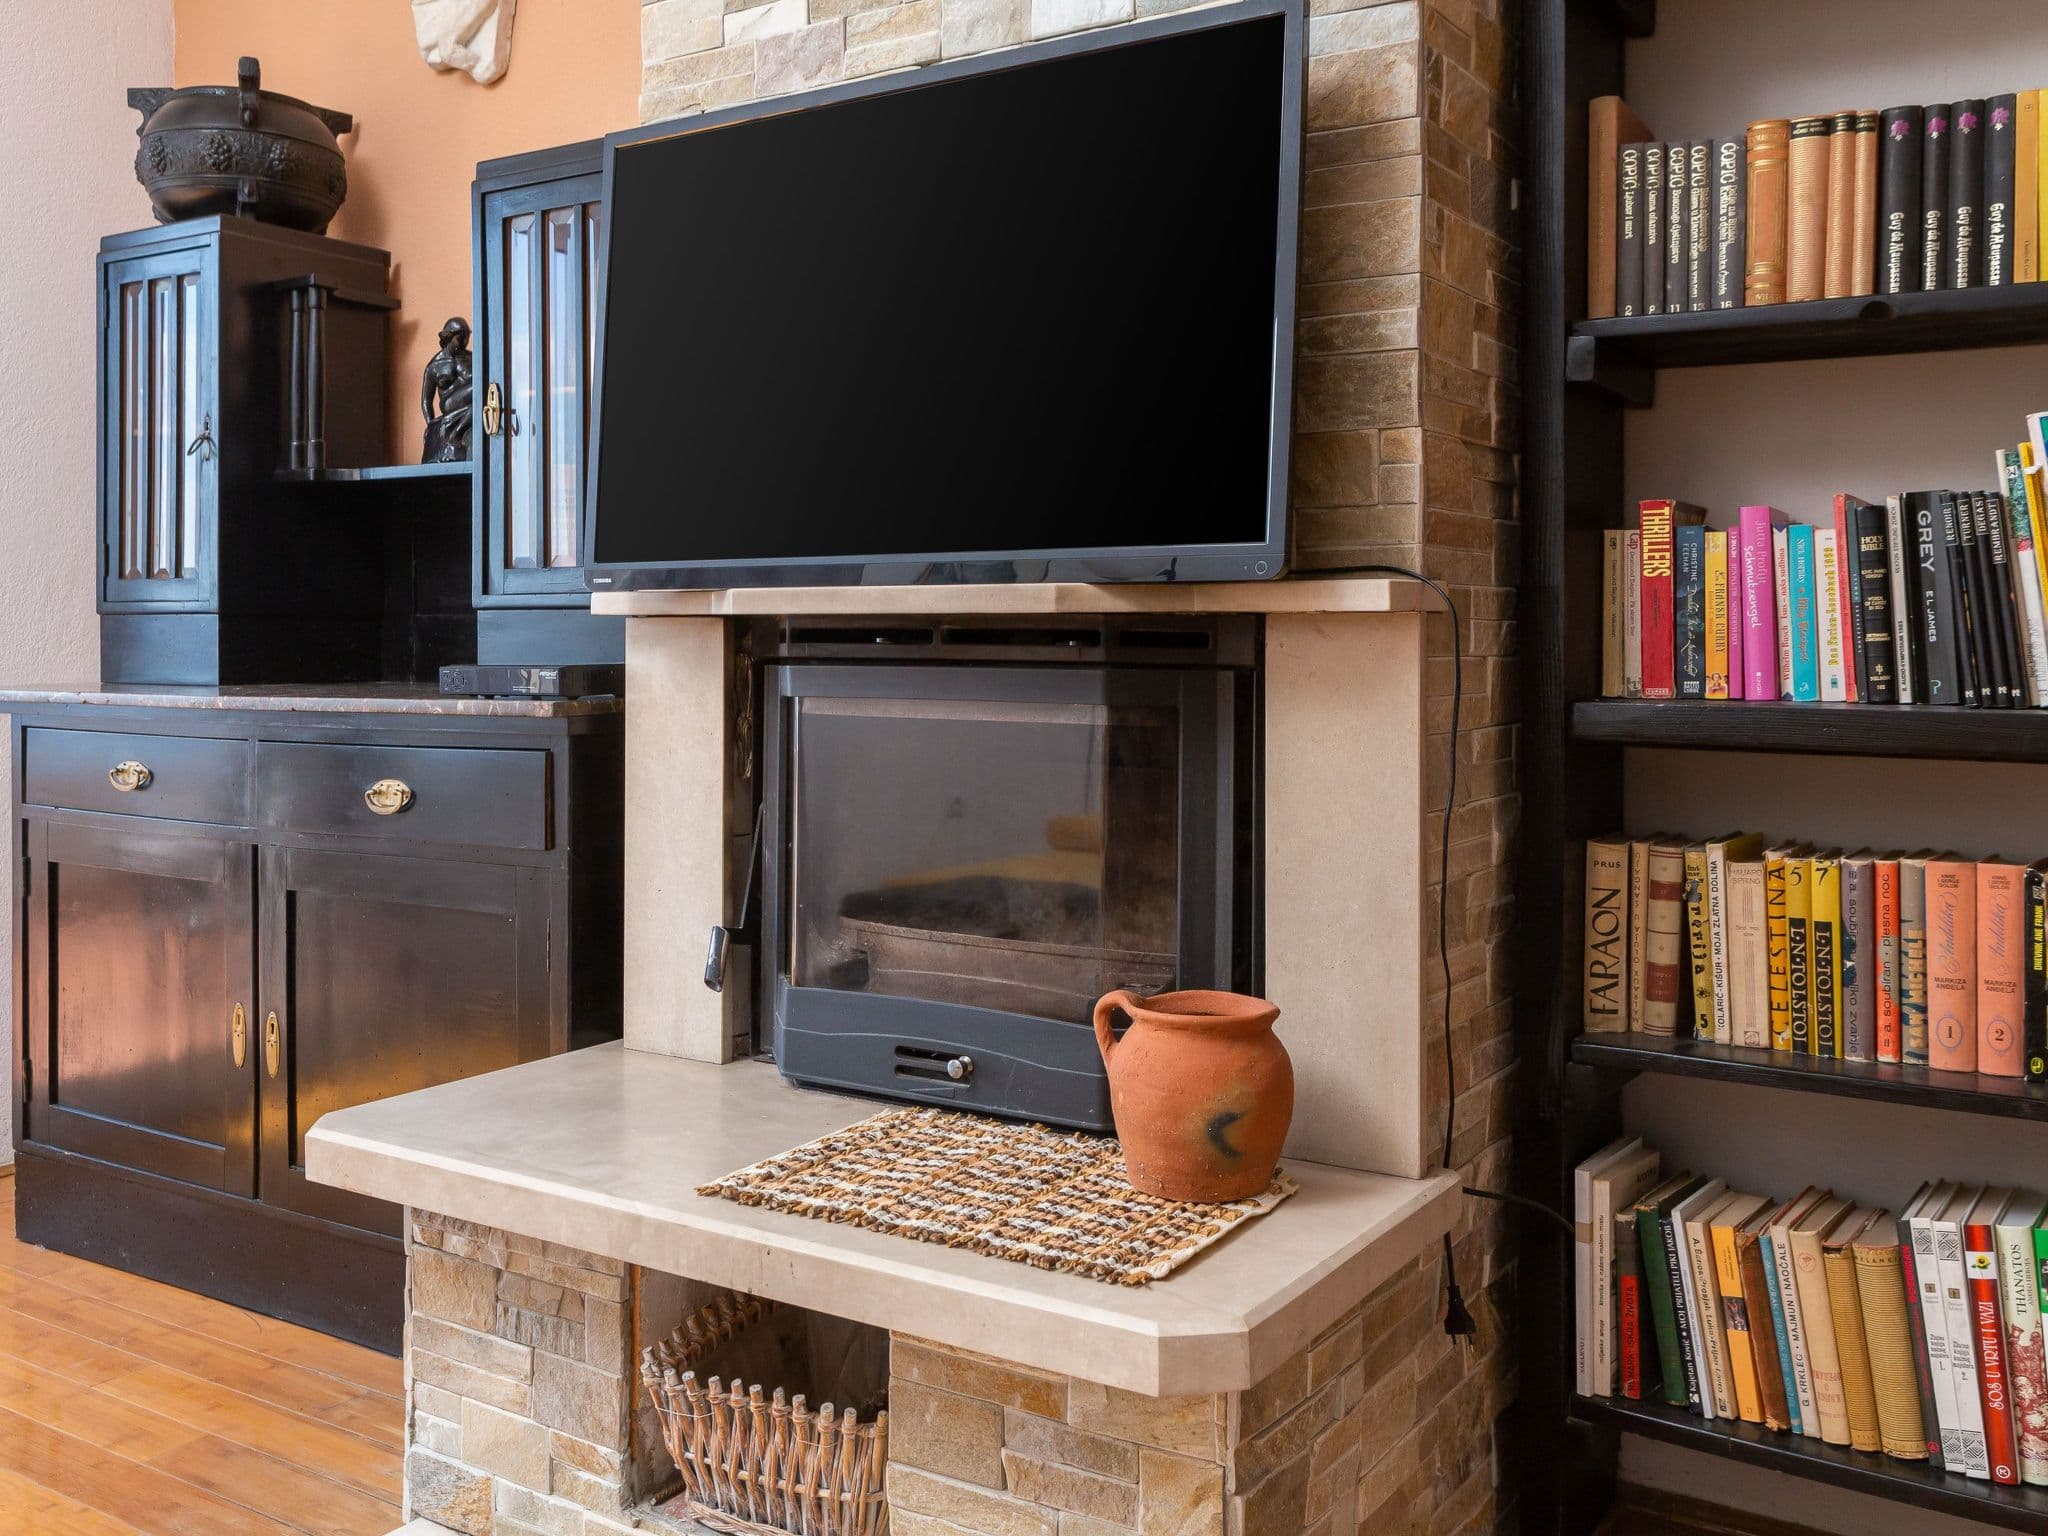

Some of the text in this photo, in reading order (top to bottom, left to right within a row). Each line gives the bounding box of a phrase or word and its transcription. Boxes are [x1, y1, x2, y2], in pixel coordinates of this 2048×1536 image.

[1888, 212, 1904, 293] Guy de Maupassan
[1923, 211, 1940, 290] Guy de Maupassan
[1956, 206, 1971, 288] Guy de Maupassan
[1989, 203, 2004, 286] Guy de Maupassan
[1943, 507, 1955, 541] RENOIR
[1960, 504, 1971, 540] TURNER
[1975, 500, 1986, 532] DEGAS
[1989, 503, 2003, 561] REMBRANDT
[1643, 507, 1670, 577] THRILLERS
[1755, 521, 1766, 548] Jutta
[1861, 543, 1884, 552] BIBLE
[1917, 511, 1935, 572] GREY
[1777, 548, 1786, 578] sudbina
[1744, 545, 1761, 628] Schmutzengel
[1780, 625, 1789, 647] Busch
[1927, 609, 1937, 642] JAMES
[1783, 650, 1791, 681] Wilhelm
[1828, 648, 1839, 666] Das
[1593, 860, 1621, 868] PRUS
[1710, 860, 1719, 893] DOLINA
[1789, 867, 1802, 885] 5
[1816, 867, 1830, 885] 7
[1711, 896, 1721, 928] ZLATNA
[1848, 899, 1858, 954] soubiran
[1589, 887, 1621, 1015] FARAON
[1713, 932, 1721, 955] MOJA
[1768, 866, 1789, 1035] CELESTINA
[2034, 905, 2044, 971] DNEVNIK ANE FRANK
[1880, 905, 1891, 1032] a. soubiran plesna
[1934, 977, 1967, 985] MARKIZA
[1984, 979, 2017, 987] MARKIZA
[1848, 967, 1858, 1005] veliko
[1700, 1014, 1708, 1028] 5
[1848, 1011, 1858, 1053] zvanje
[1947, 1026, 1953, 1039] 1
[1995, 1029, 2004, 1041] 2
[1664, 1225, 1676, 1251] JAKOB
[1669, 1253, 1677, 1269] PIKI
[1777, 1243, 1791, 1290] NAOČALE
[1671, 1271, 1685, 1308] PRIJATELJ
[2011, 1244, 2027, 1315] THANATOS
[1625, 1286, 1634, 1347] ISKRA ŽIVOTA
[1677, 1310, 1687, 1329] MOJ
[1787, 1300, 1800, 1342] MAJMUN
[1978, 1301, 1995, 1325] VAZI
[1985, 1335, 2000, 1366] VRTU
[1686, 1362, 1696, 1391] Kajetan
[1989, 1370, 2001, 1378] U
[1986, 1382, 2004, 1410] SOS
